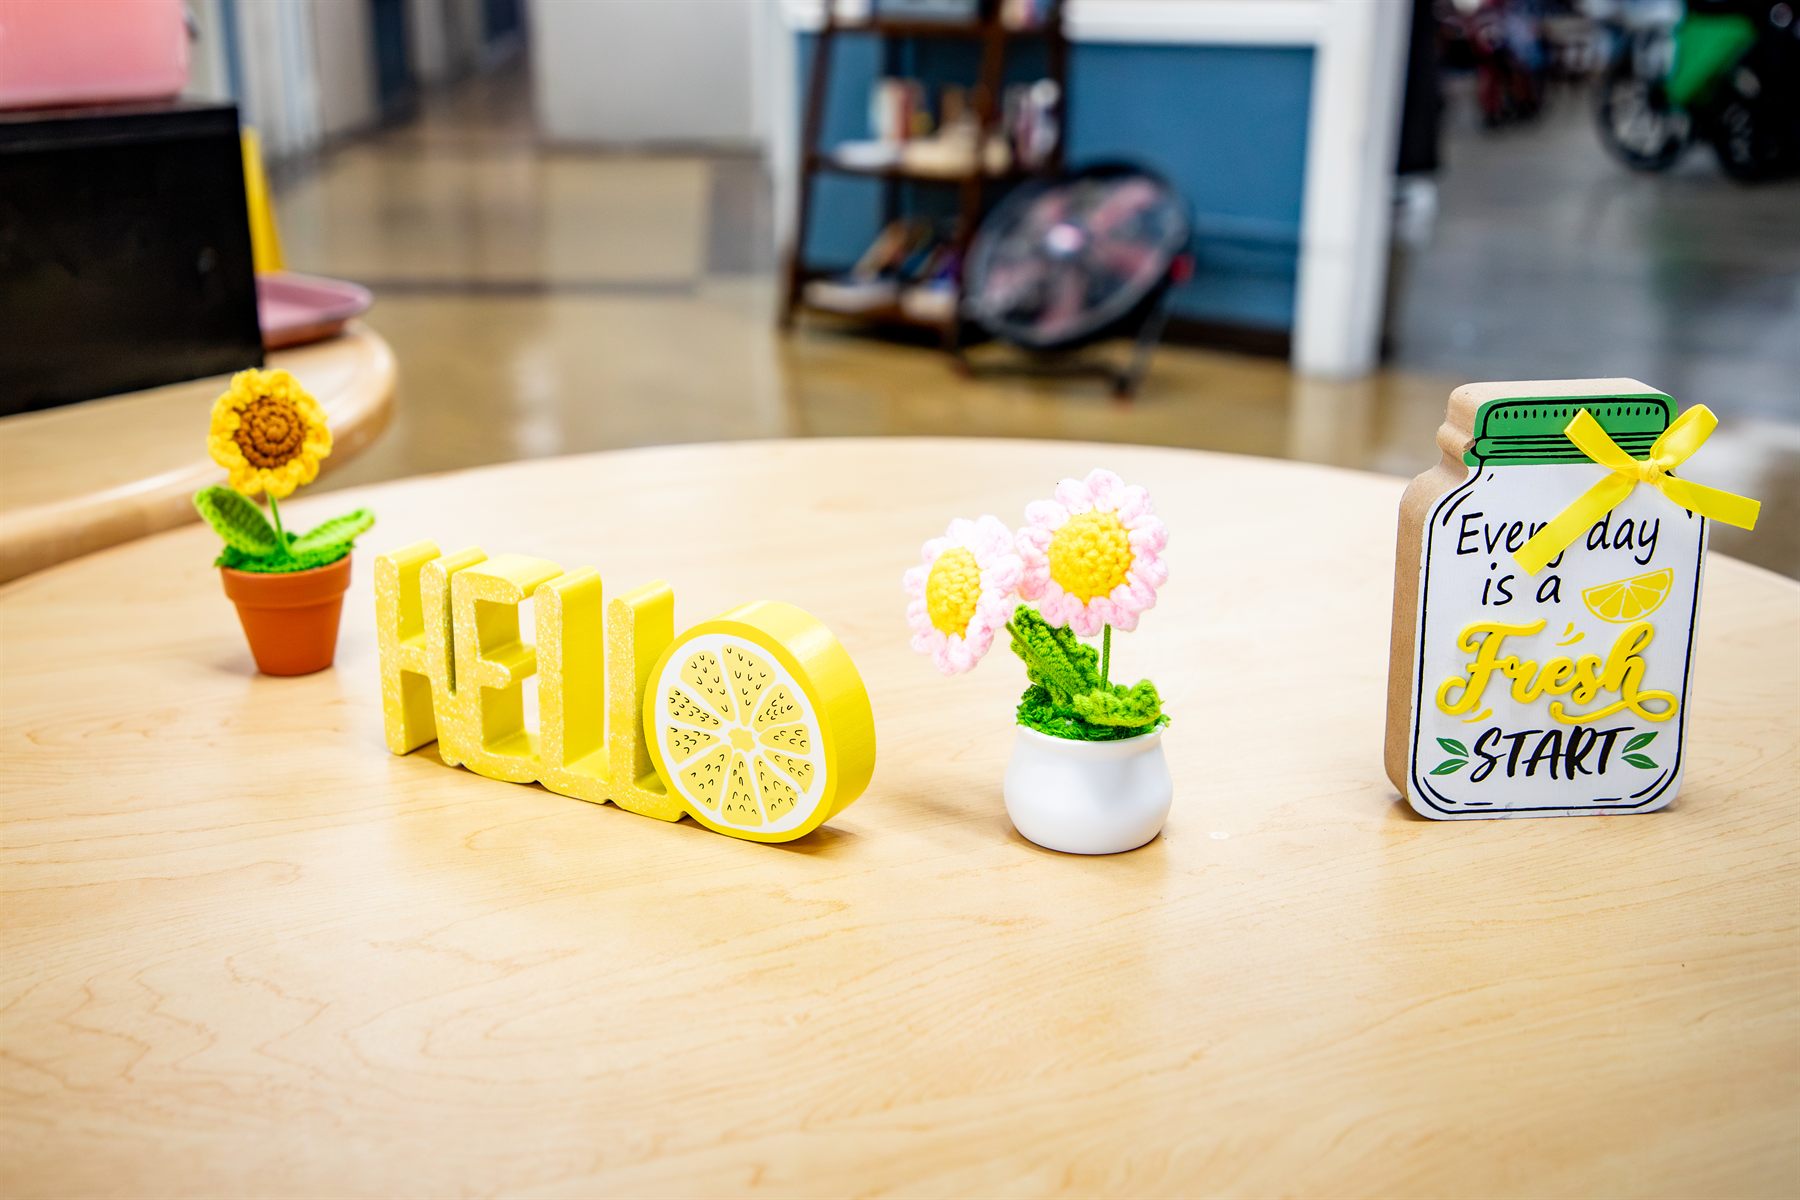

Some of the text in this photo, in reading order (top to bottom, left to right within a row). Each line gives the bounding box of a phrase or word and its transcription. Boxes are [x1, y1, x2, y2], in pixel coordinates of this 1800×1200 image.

[1586, 509, 1660, 565] day
[1481, 562, 1562, 606] is a
[1435, 618, 1679, 725] Fresh
[1469, 725, 1636, 783] START
